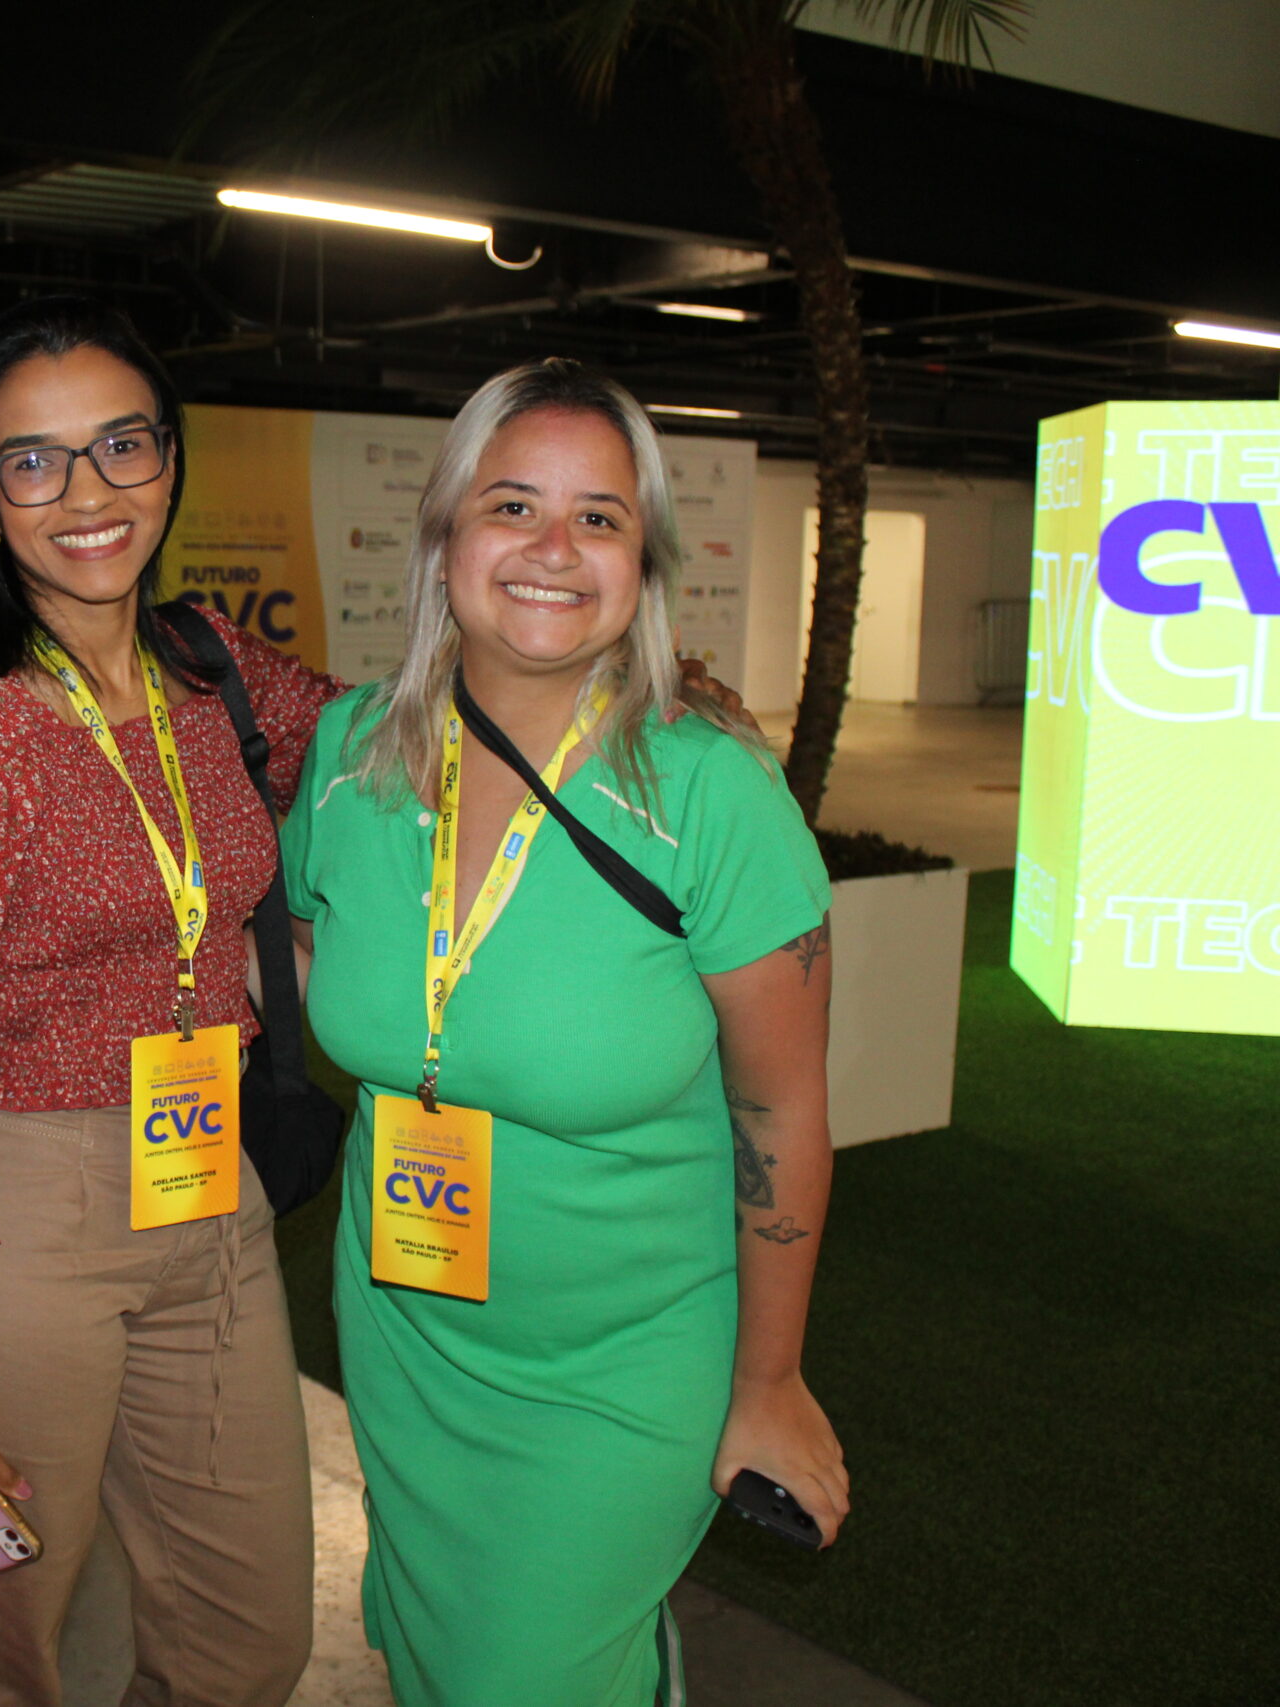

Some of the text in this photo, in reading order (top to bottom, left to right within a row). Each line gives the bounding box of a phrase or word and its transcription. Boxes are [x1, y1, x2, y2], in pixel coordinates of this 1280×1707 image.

[182, 566, 260, 584] FUTURO
[82, 707, 105, 740] CVC
[154, 705, 168, 736] CVC
[444, 761, 455, 795] CVC
[184, 908, 200, 941] CVC
[433, 978, 445, 1013] CVC
[151, 1091, 200, 1109] FUTURO
[144, 1102, 223, 1144] CVC
[151, 1169, 217, 1186] ADELANNA SANTOS
[393, 1158, 446, 1177] FUTURO
[174, 1181, 194, 1191] PAULO
[385, 1172, 471, 1215] CVC
[395, 1238, 460, 1257] NATALIA BRAULIO
[415, 1250, 437, 1260] PAULO
